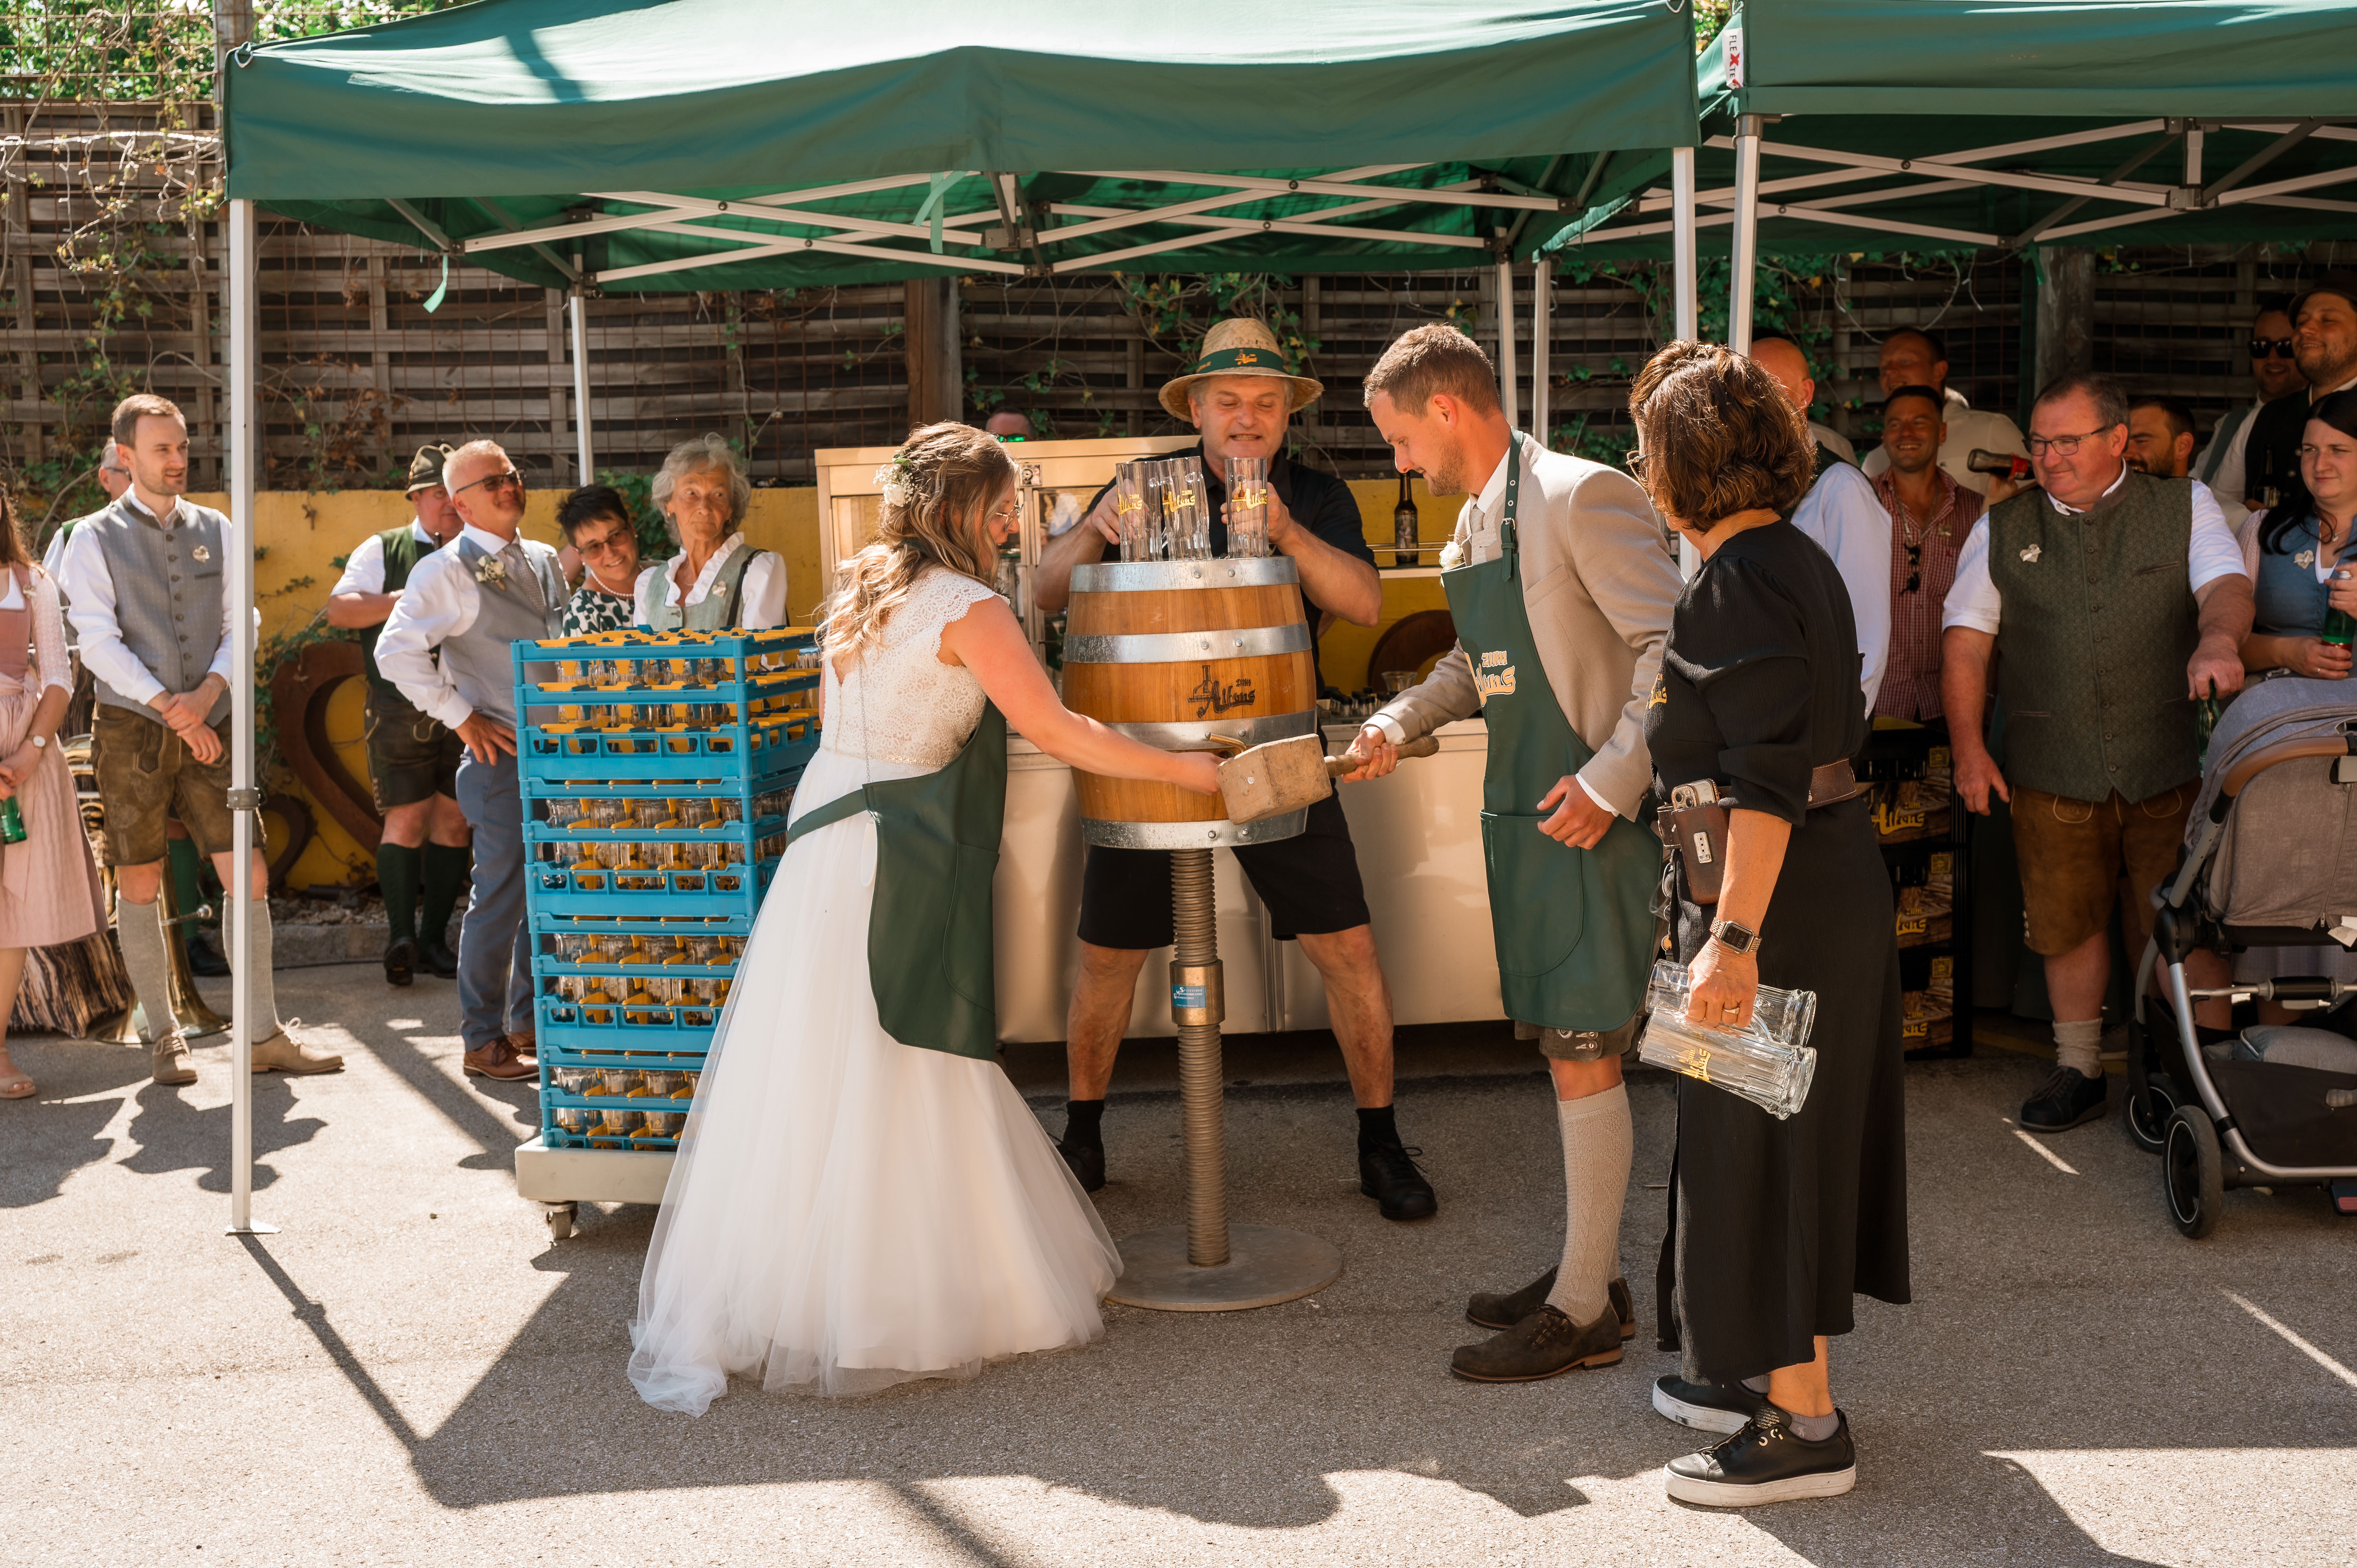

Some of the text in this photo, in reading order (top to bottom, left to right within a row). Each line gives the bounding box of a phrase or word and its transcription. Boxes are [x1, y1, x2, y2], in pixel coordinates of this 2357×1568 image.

[1164, 491, 1196, 515] Alfons
[1481, 650, 1508, 667] zum
[1235, 678, 1251, 687] zum
[1197, 680, 1255, 718] Alfons
[1872, 803, 1925, 835] Alfons
[1896, 915, 1927, 936] fons
[1687, 1049, 1696, 1063] zum
